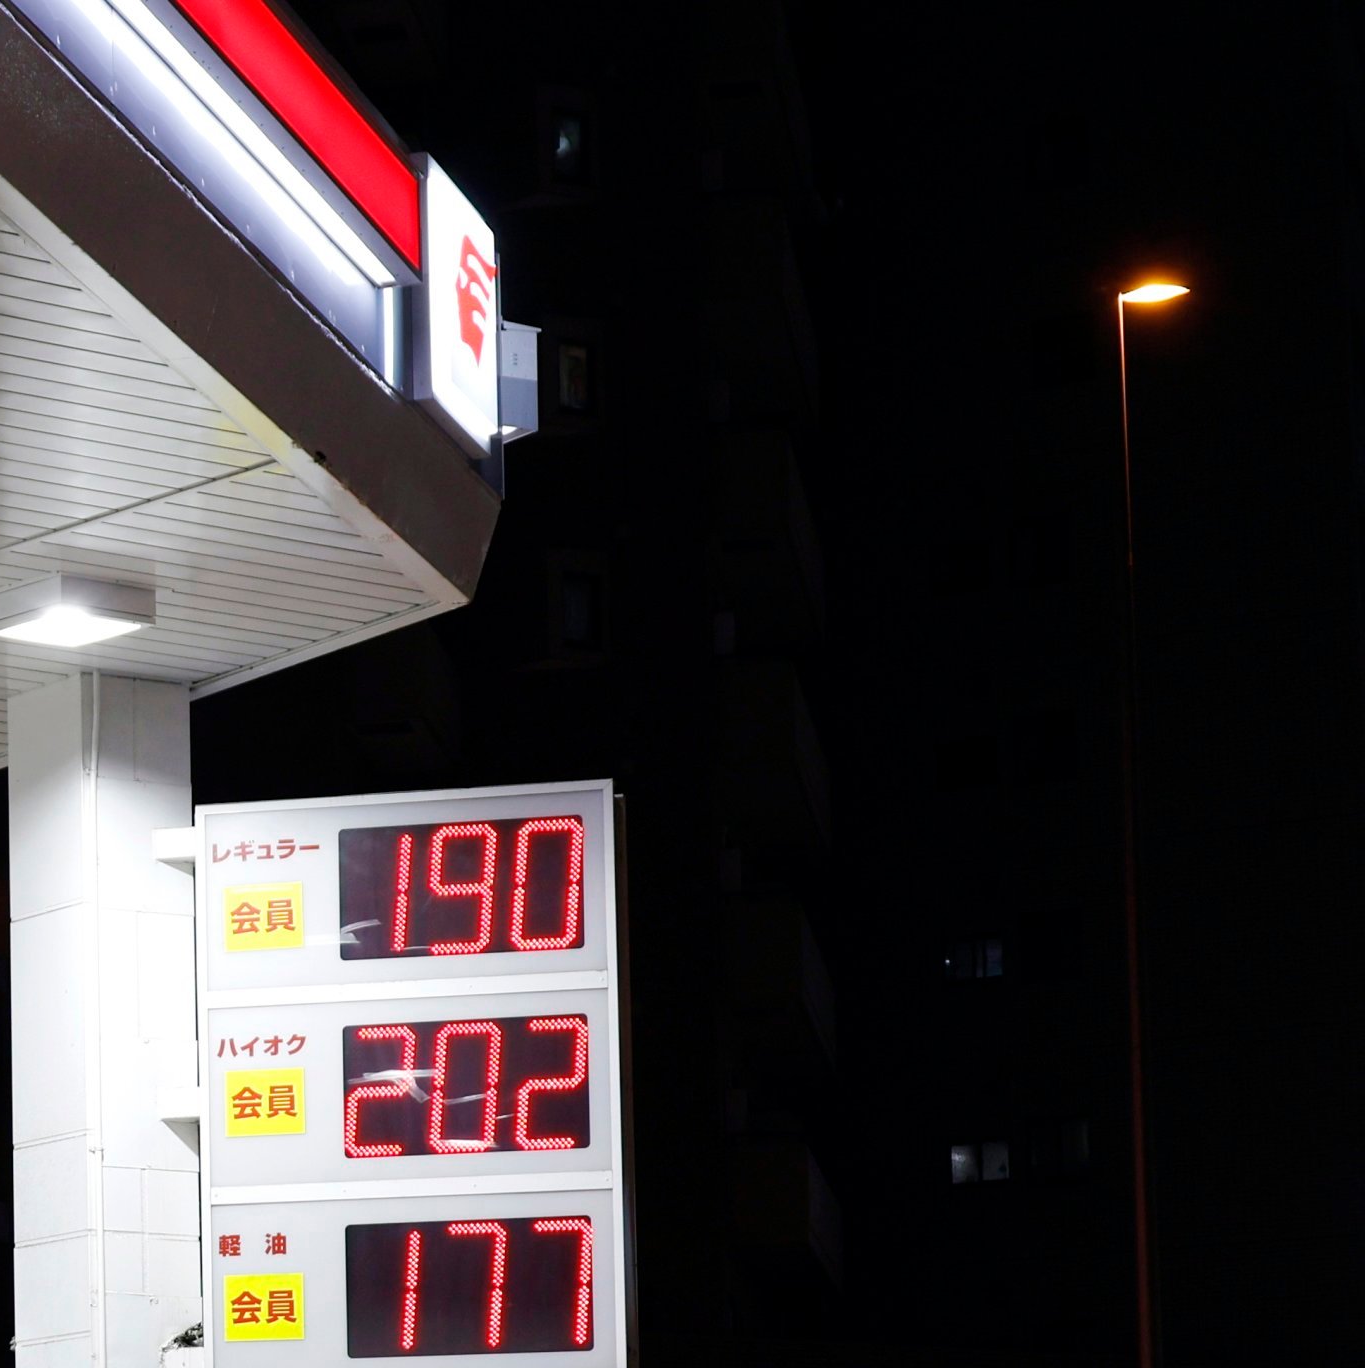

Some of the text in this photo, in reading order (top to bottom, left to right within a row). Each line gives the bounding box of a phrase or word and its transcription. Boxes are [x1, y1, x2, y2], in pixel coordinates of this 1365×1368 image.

[210, 837, 320, 863] レギュラー
[388, 813, 584, 957] 190
[230, 901, 297, 934] 会員
[216, 1033, 307, 1059] ハイオク
[230, 1087, 298, 1121] 会員
[344, 1016, 589, 1158] 202
[397, 1219, 593, 1351] 177
[230, 1291, 297, 1325] 会員
